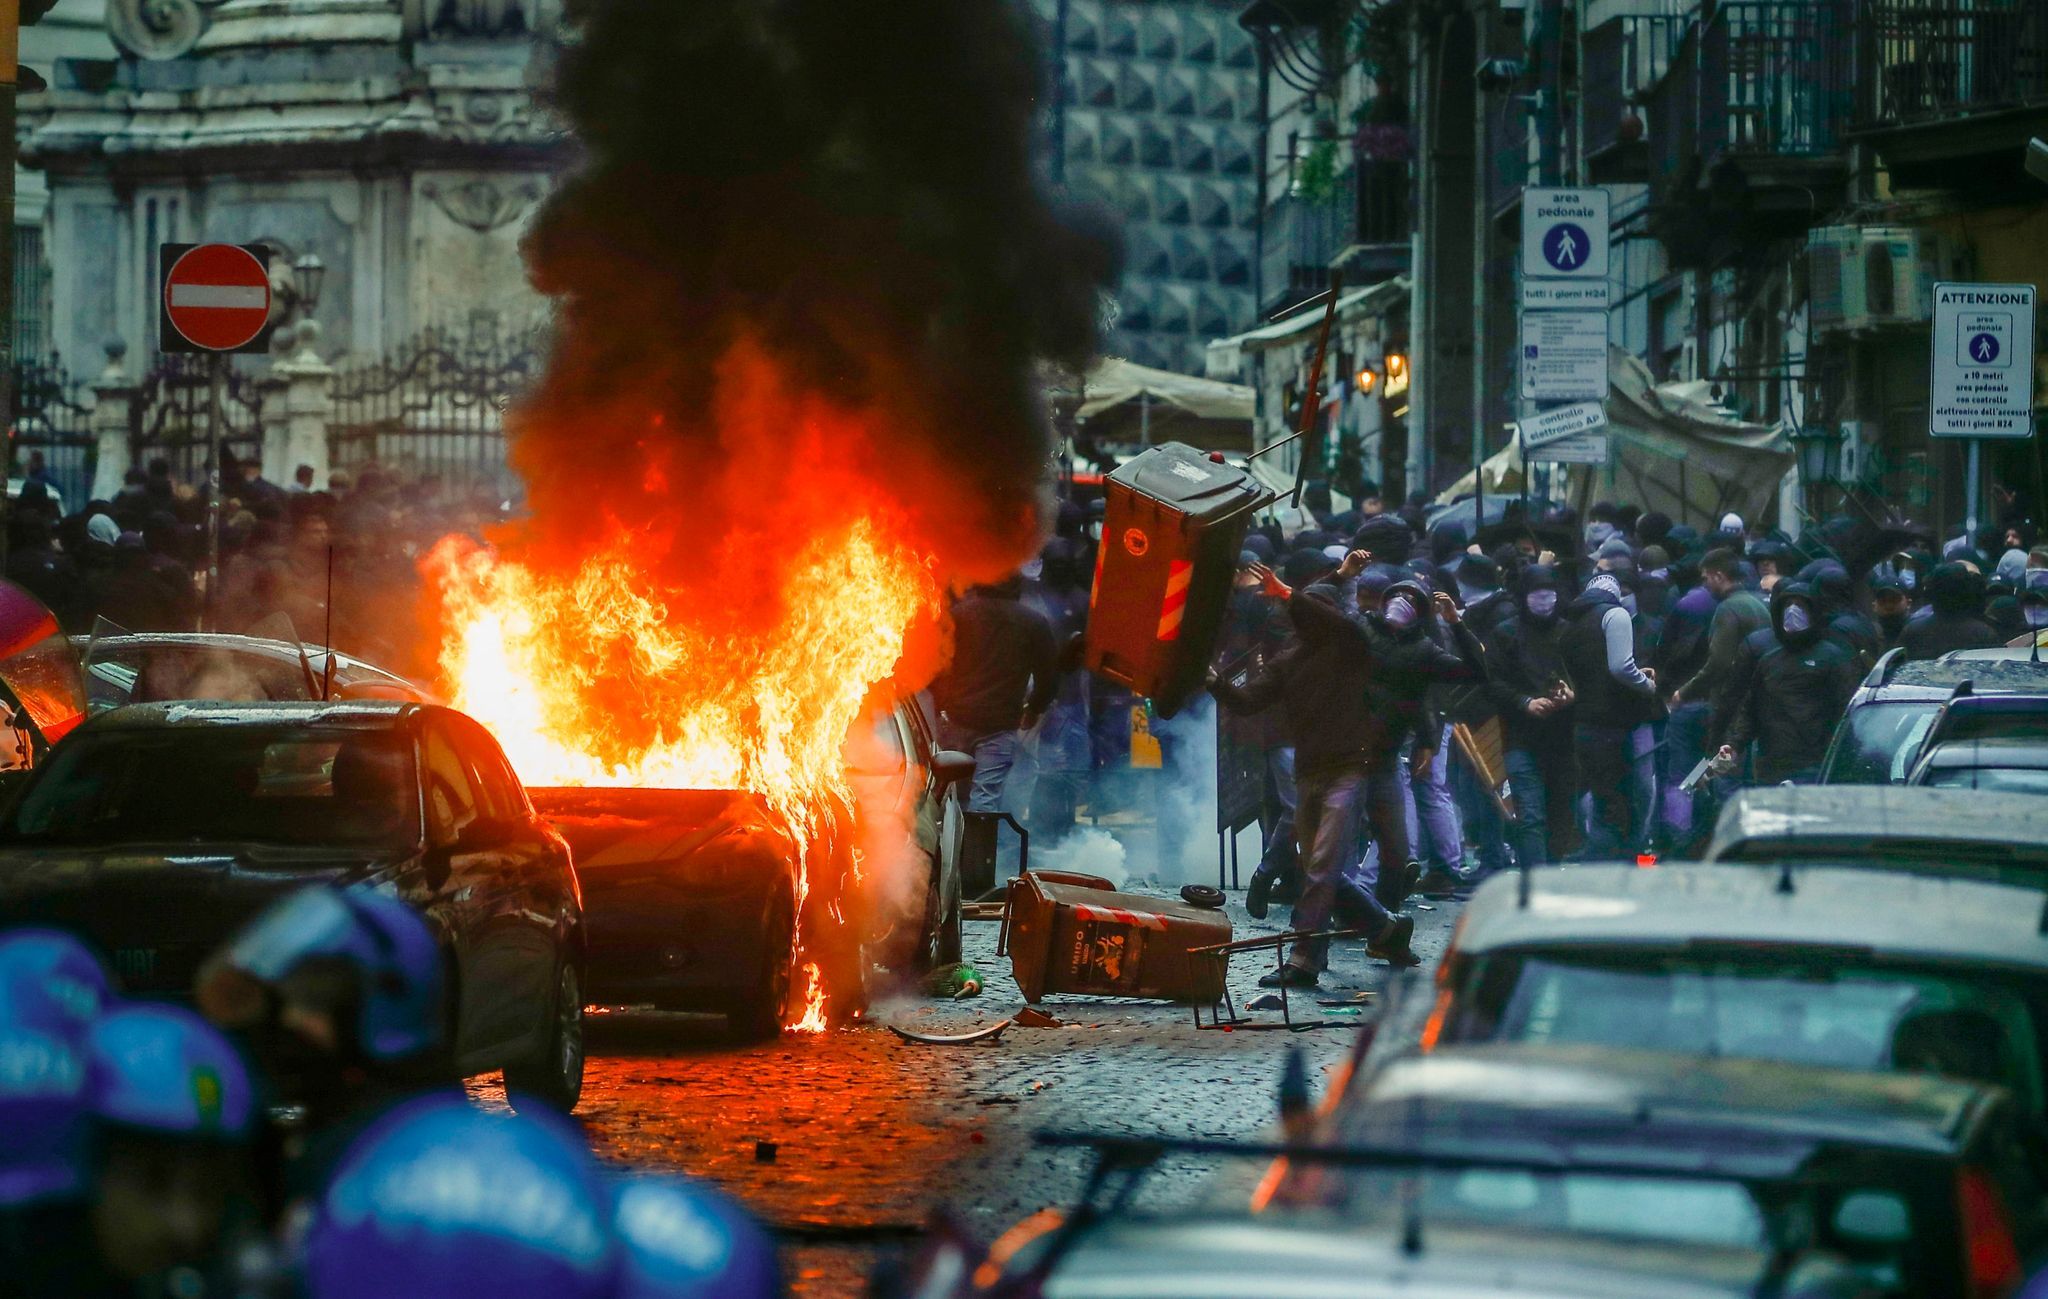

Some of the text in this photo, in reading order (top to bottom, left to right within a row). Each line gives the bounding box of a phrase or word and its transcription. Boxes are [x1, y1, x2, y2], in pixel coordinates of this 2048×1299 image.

[1553, 194, 1579, 203] area
[1537, 206, 1594, 218] pedonale
[1525, 289, 1546, 298] tutti
[1556, 290, 1582, 300] giorni
[1585, 289, 1606, 298] H24
[1941, 293, 2029, 304] ATTENZIONE
[1972, 371, 1980, 379] 10
[1975, 383, 2008, 393] pedonale
[1972, 395, 2007, 404] controllo
[1540, 408, 1583, 425] controllo
[1936, 407, 2027, 416] elettronico dell'accesso
[1530, 415, 1599, 440] elettronico AP
[1973, 420, 1994, 429] giorni
[1997, 420, 2012, 428] H24
[1071, 931, 1084, 973] UMIDO
